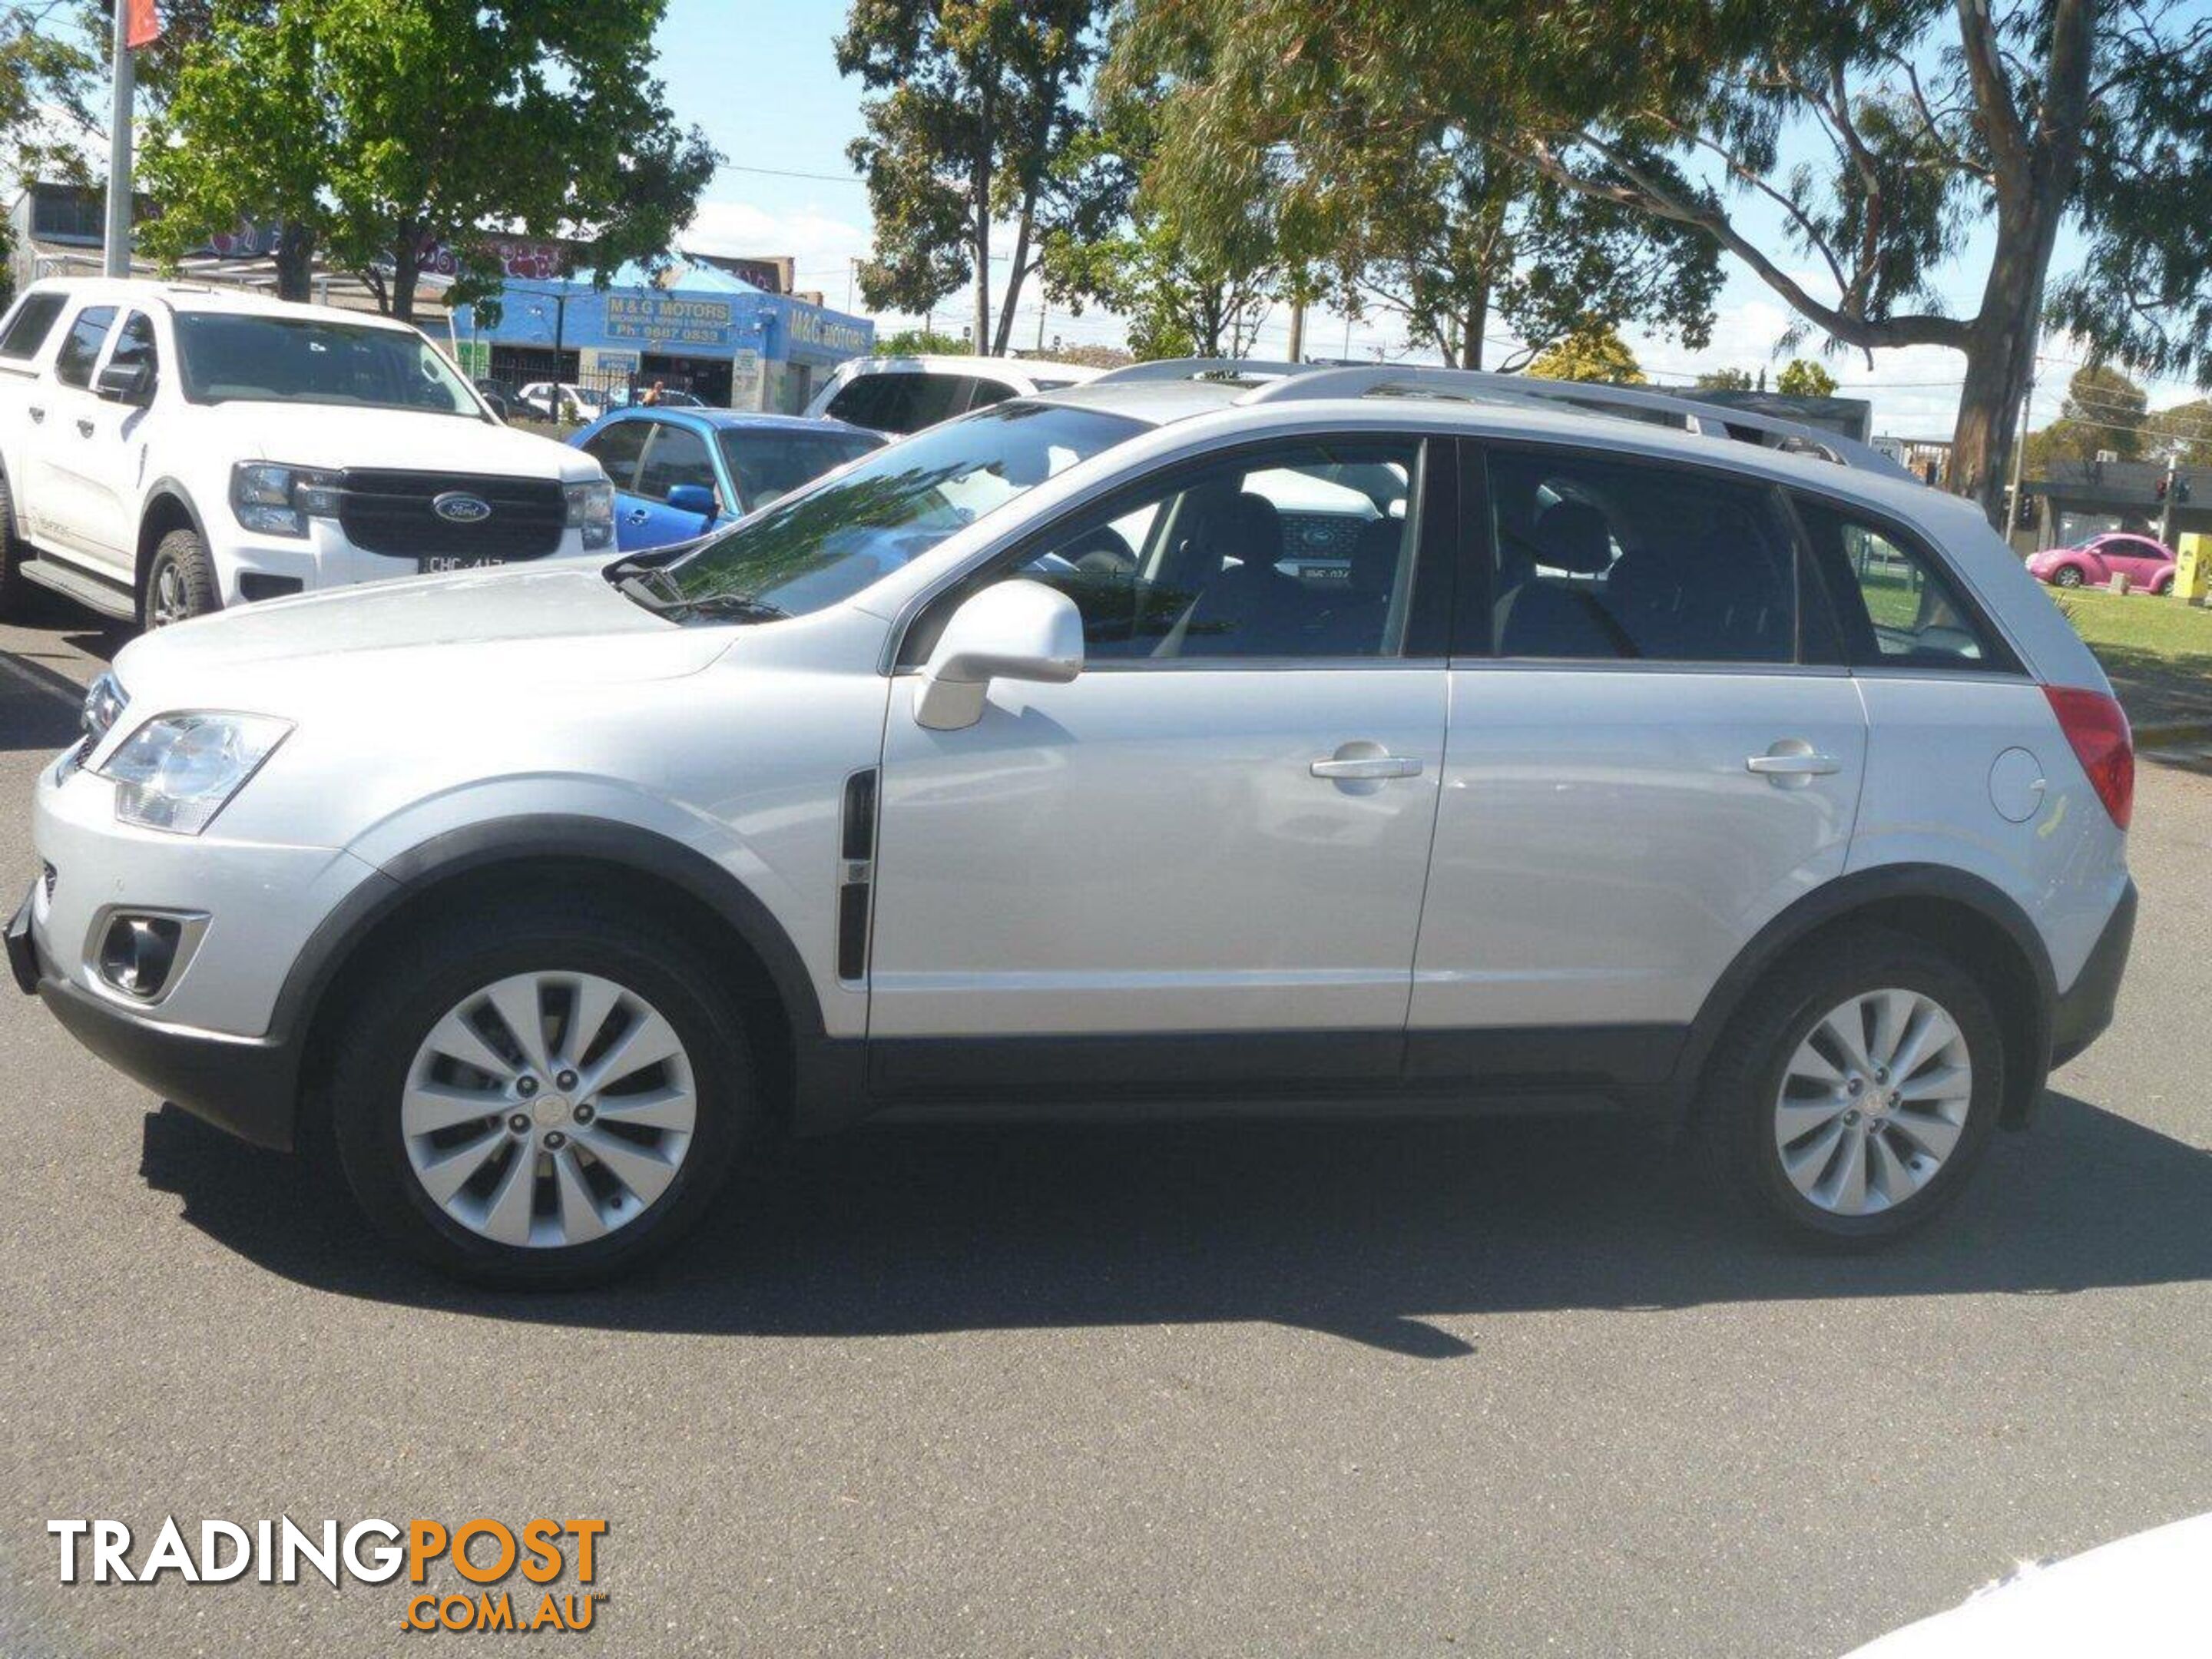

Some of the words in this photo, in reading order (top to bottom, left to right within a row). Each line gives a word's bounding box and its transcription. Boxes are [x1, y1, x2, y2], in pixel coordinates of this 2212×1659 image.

[611, 298, 623, 313] M
[627, 300, 637, 314] &
[642, 300, 653, 314] G
[659, 302, 727, 319] MOTORS
[449, 503, 479, 517] Ford
